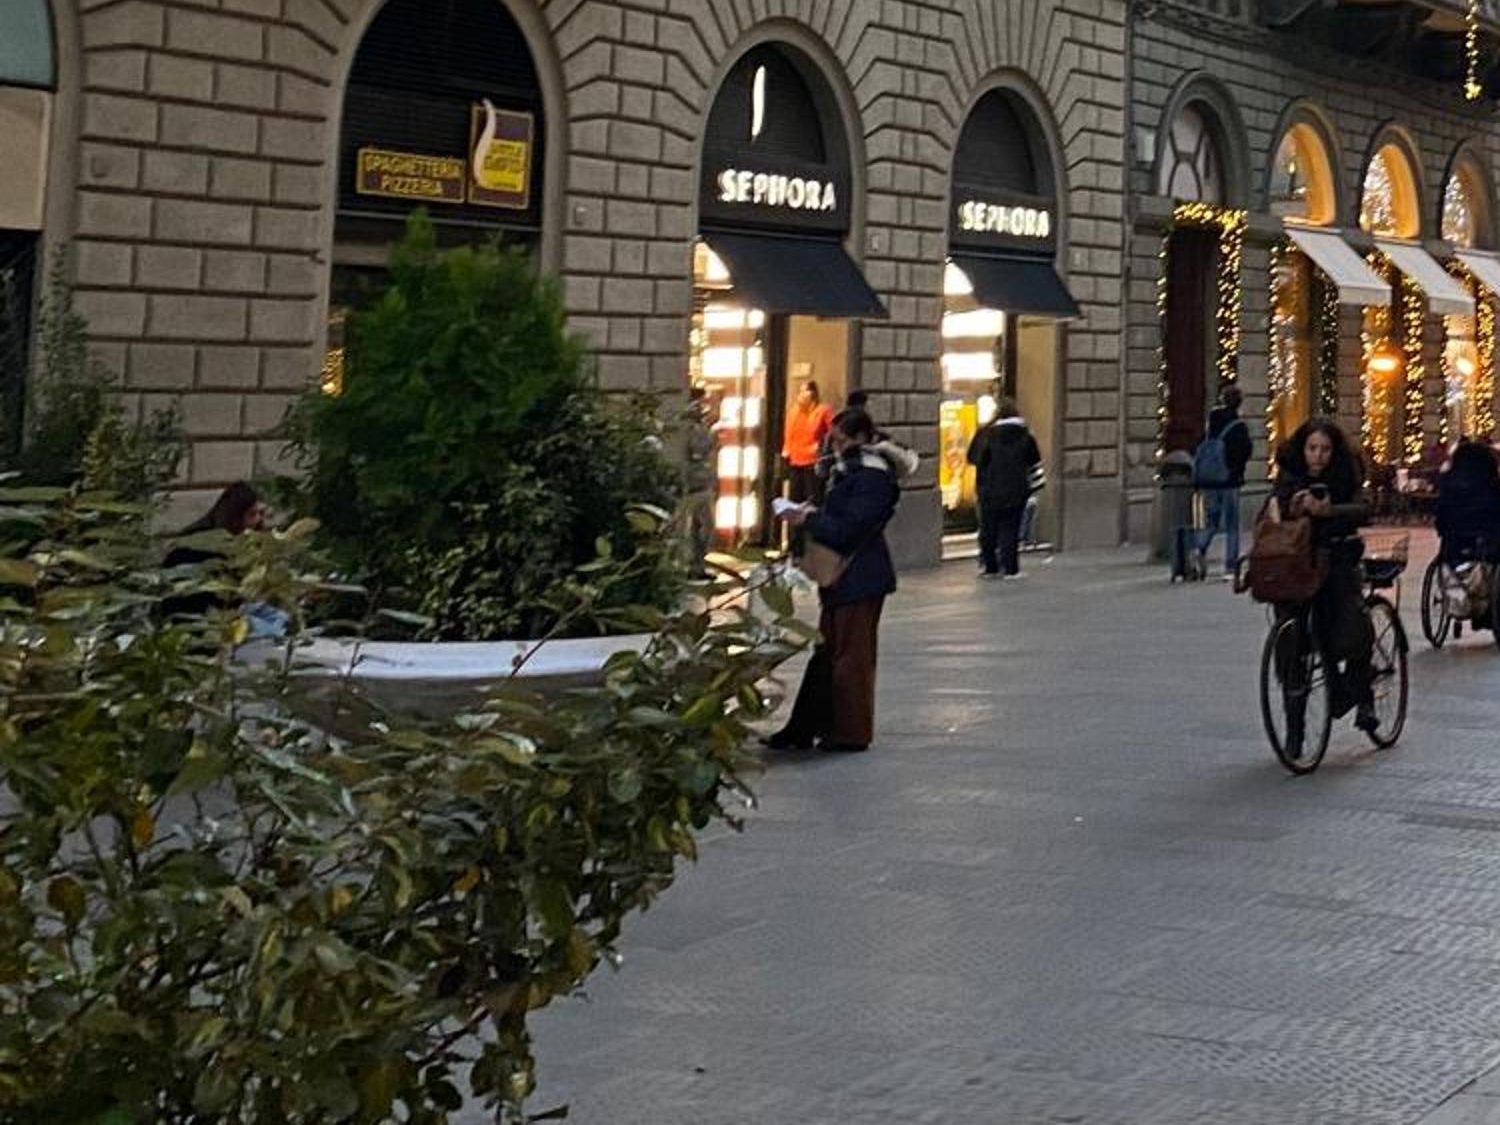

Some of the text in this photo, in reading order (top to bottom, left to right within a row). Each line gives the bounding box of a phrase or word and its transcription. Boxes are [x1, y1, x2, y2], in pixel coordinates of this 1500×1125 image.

[382, 175, 443, 195] PIZZERIA
[717, 168, 836, 211] SEPHORA
[959, 201, 1049, 237] SEPHORA
